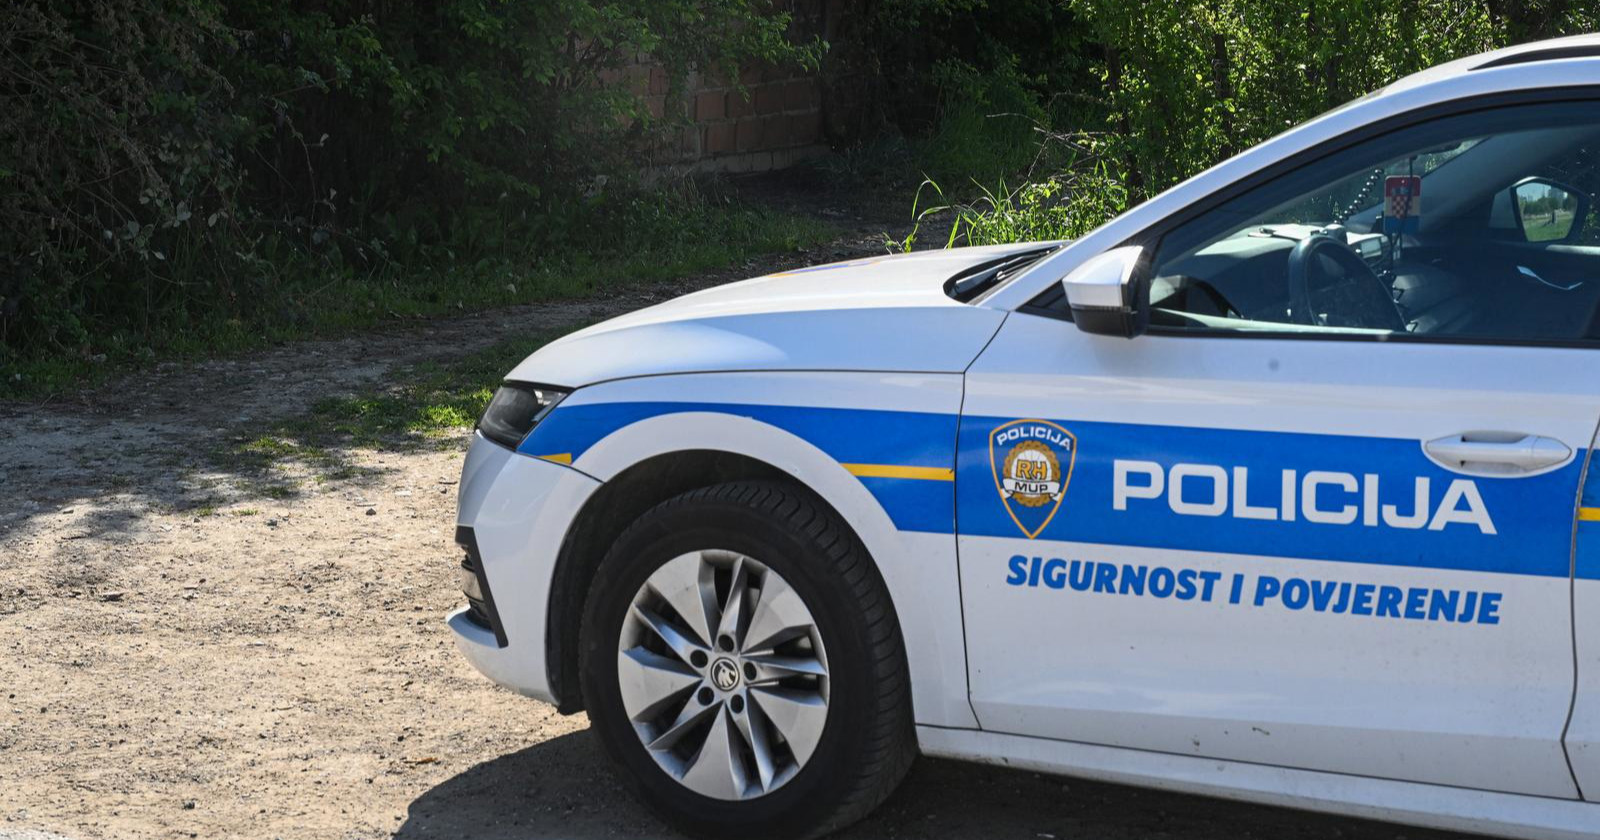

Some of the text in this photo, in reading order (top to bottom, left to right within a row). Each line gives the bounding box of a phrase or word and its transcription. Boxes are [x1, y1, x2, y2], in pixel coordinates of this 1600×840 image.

[996, 426, 1071, 451] POLICIJA
[1015, 459, 1048, 480] RH
[1014, 481, 1049, 494] MUP
[1112, 459, 1498, 535] POLICIJA
[1006, 555, 1503, 625] SIGURNOST I POVJERENJE
